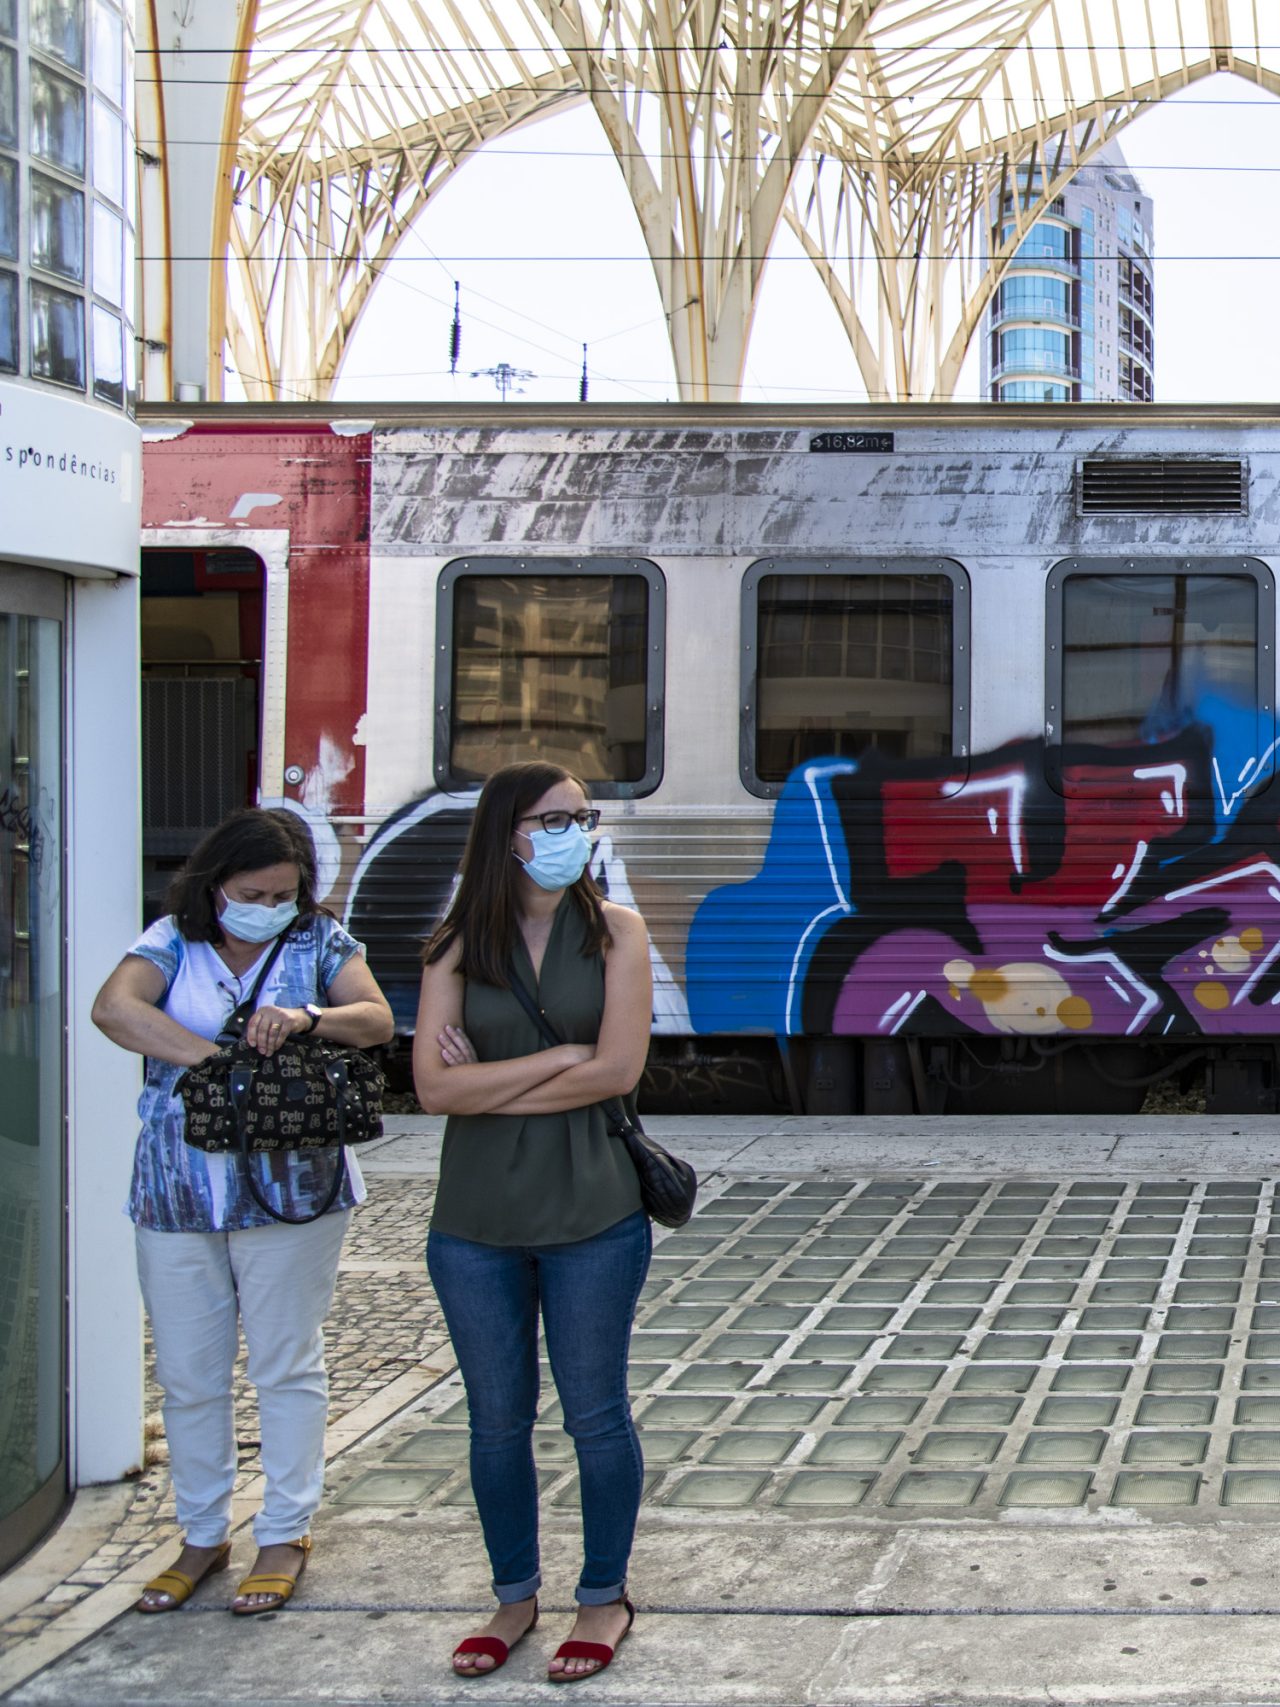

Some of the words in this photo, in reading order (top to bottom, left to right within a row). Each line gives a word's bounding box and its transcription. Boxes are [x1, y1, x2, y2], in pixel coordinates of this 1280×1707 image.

[824, 435, 879, 451] 16,82m
[278, 1054, 301, 1066] Pelu
[281, 1066, 301, 1078] che
[256, 1082, 281, 1095] Pelu
[258, 1095, 279, 1106] che
[304, 1094, 325, 1105] che
[190, 1112, 212, 1124] Pelu
[280, 1111, 304, 1123] Pelu
[281, 1123, 302, 1135] che
